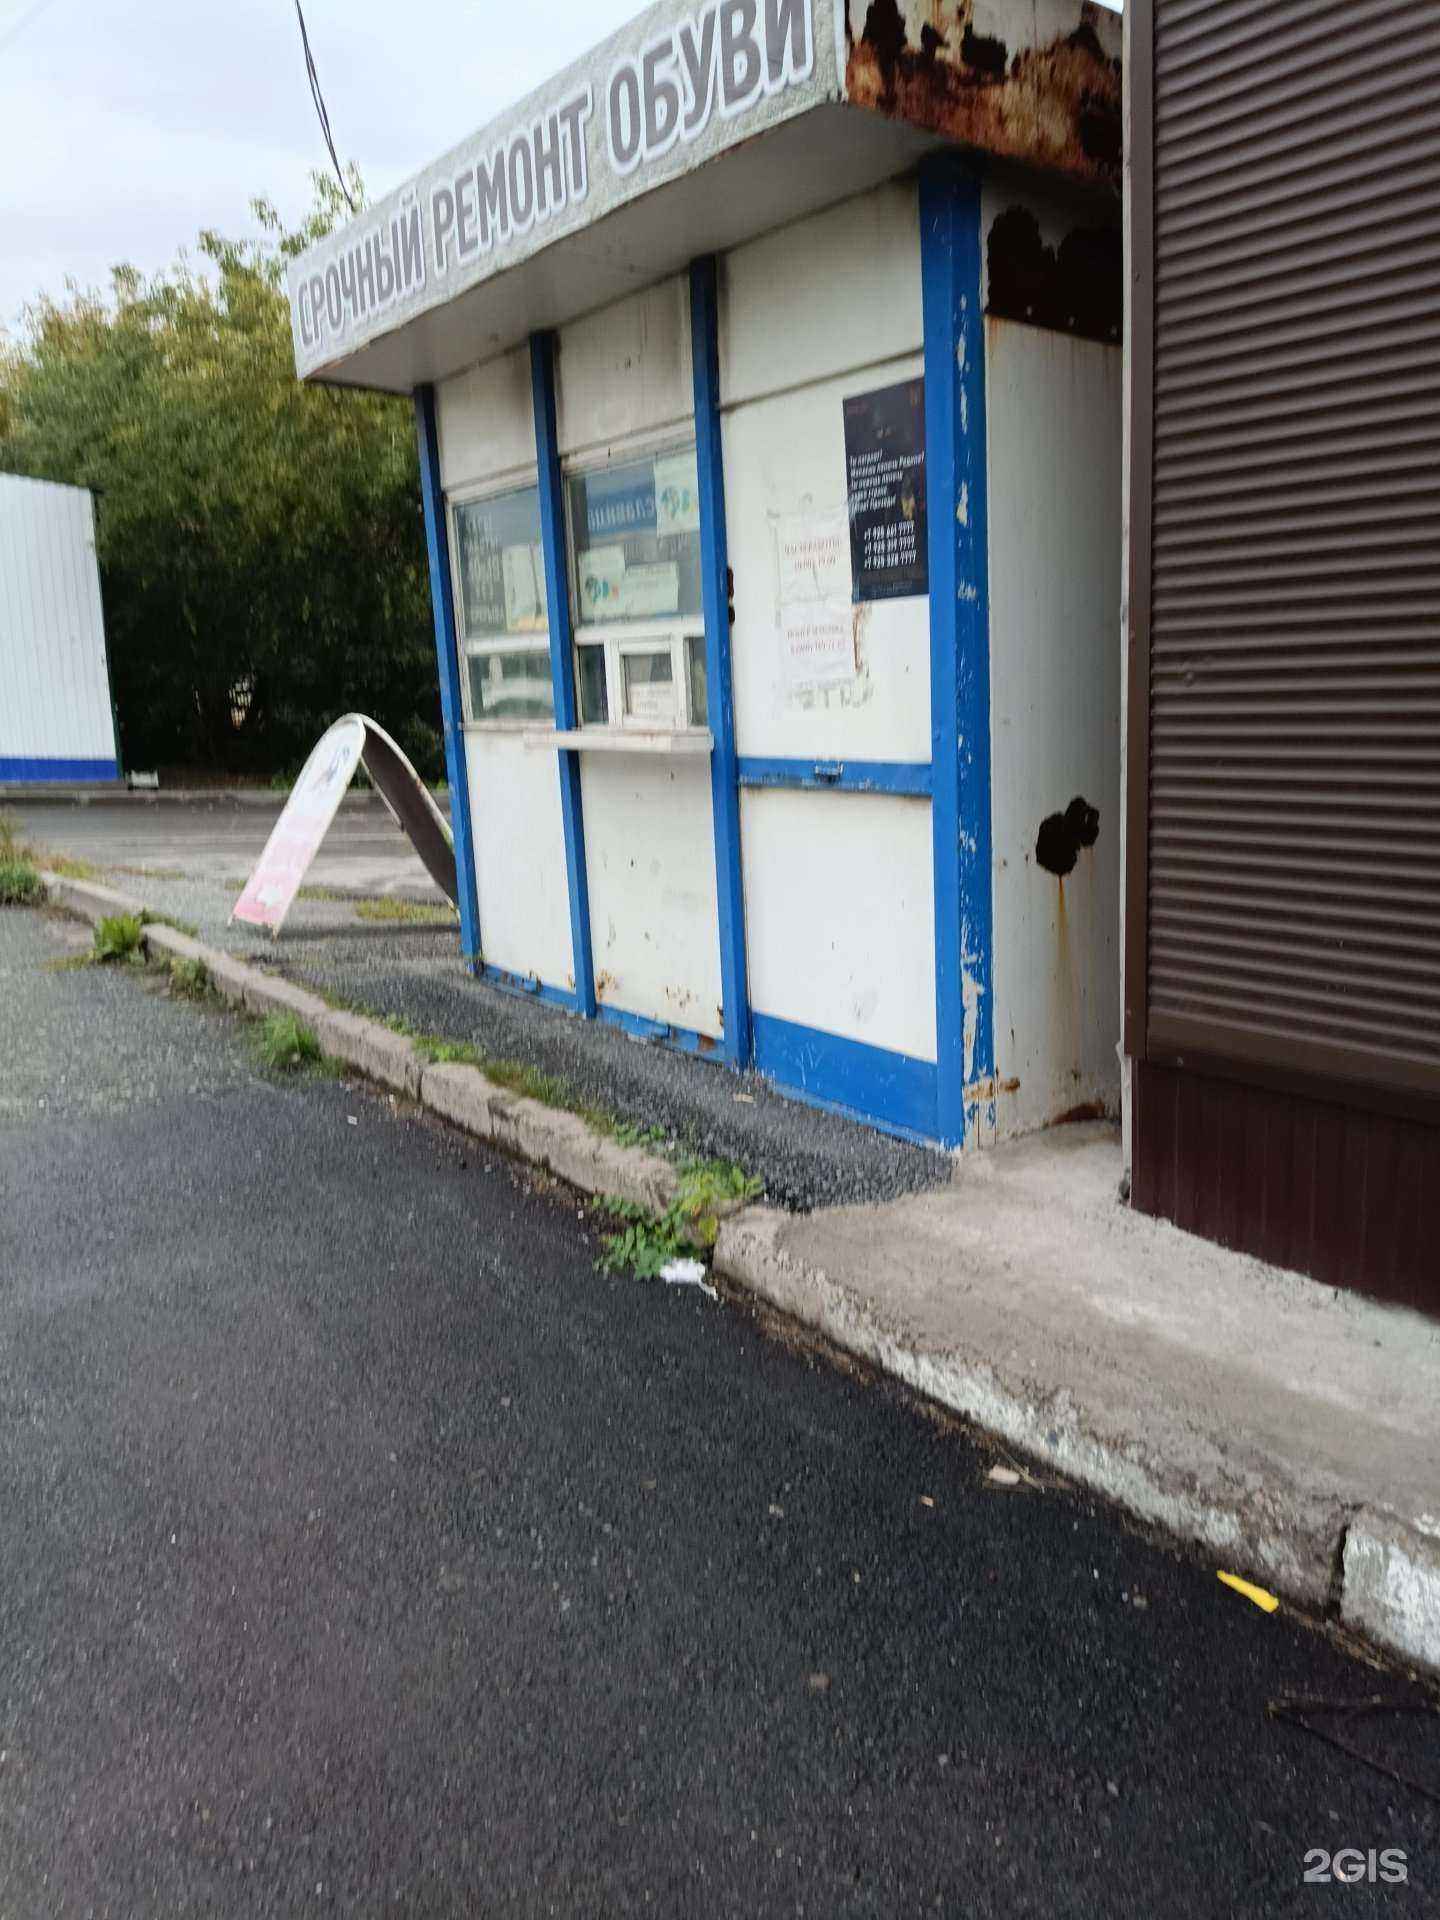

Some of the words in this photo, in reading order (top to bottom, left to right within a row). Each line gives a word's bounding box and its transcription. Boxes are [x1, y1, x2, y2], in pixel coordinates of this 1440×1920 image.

[298, 193, 425, 344] СРОЧНЫЙ
[432, 93, 591, 270] РЕМОНТ
[608, 0, 814, 166] ОБУВИ
